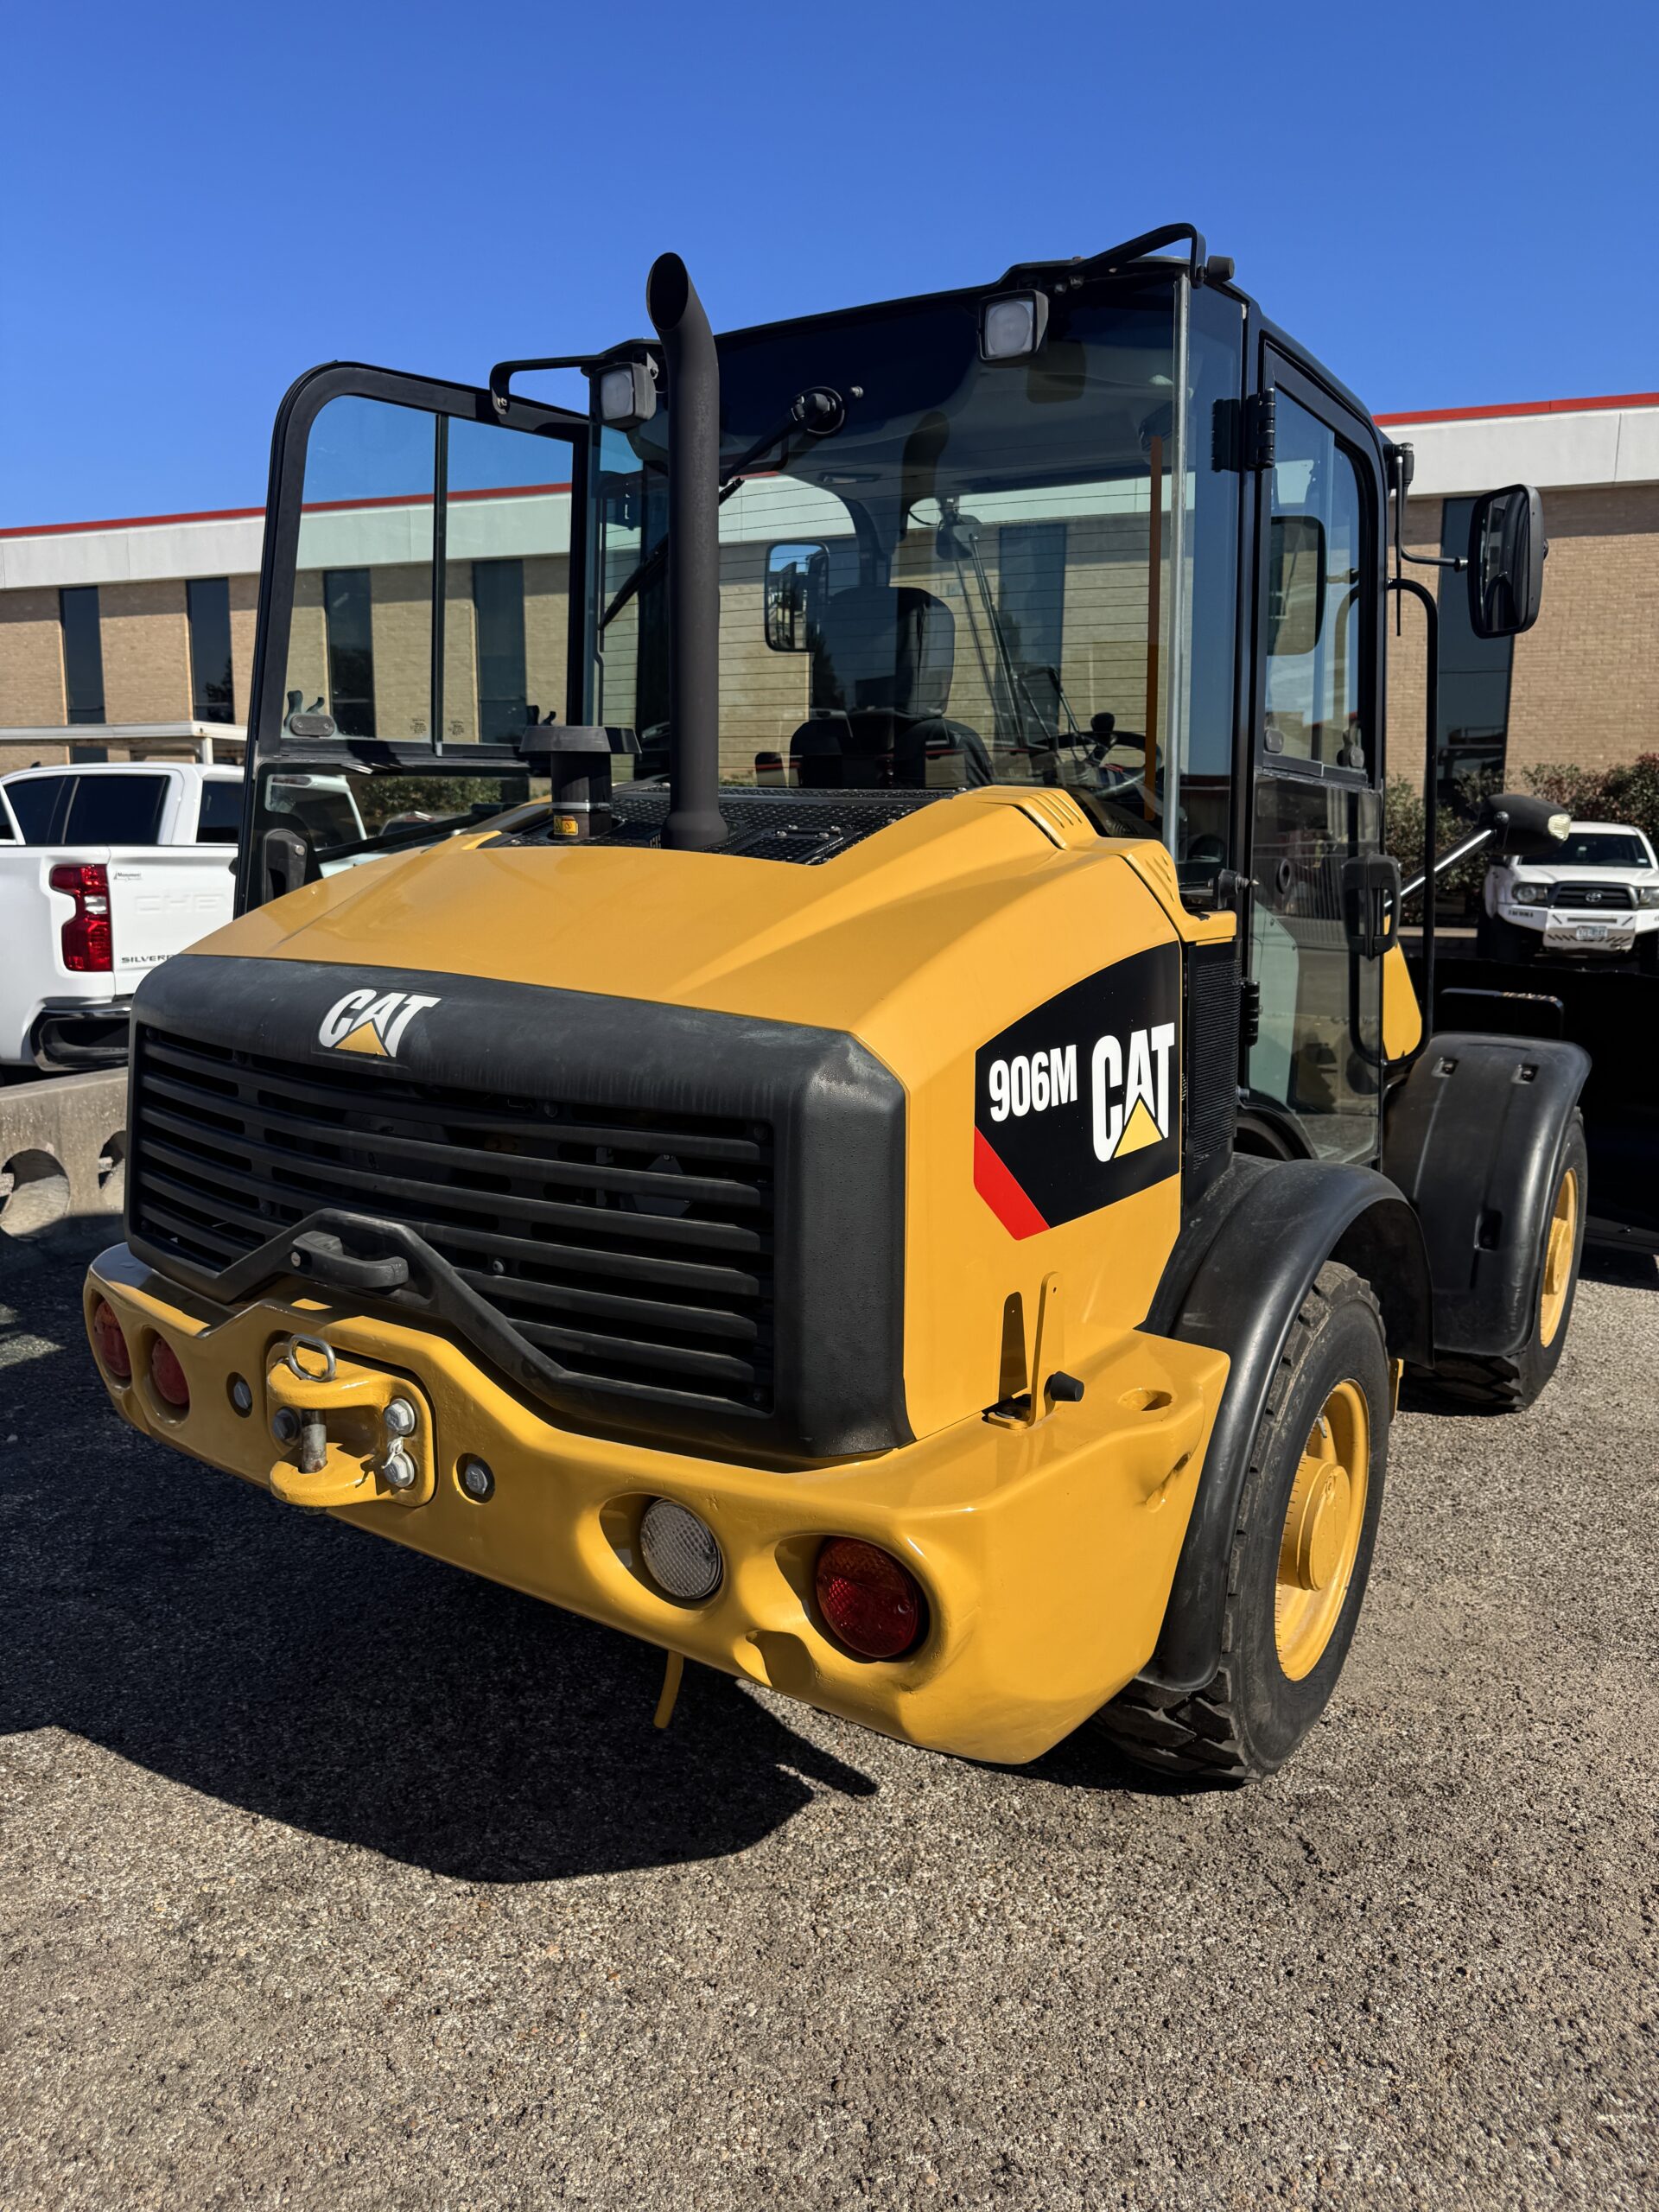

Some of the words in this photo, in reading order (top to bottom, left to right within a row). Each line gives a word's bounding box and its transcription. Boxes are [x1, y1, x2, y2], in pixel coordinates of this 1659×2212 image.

[318, 988, 442, 1058] CAT
[988, 1044, 1078, 1122] 906M
[1091, 1022, 1176, 1163] CAT
